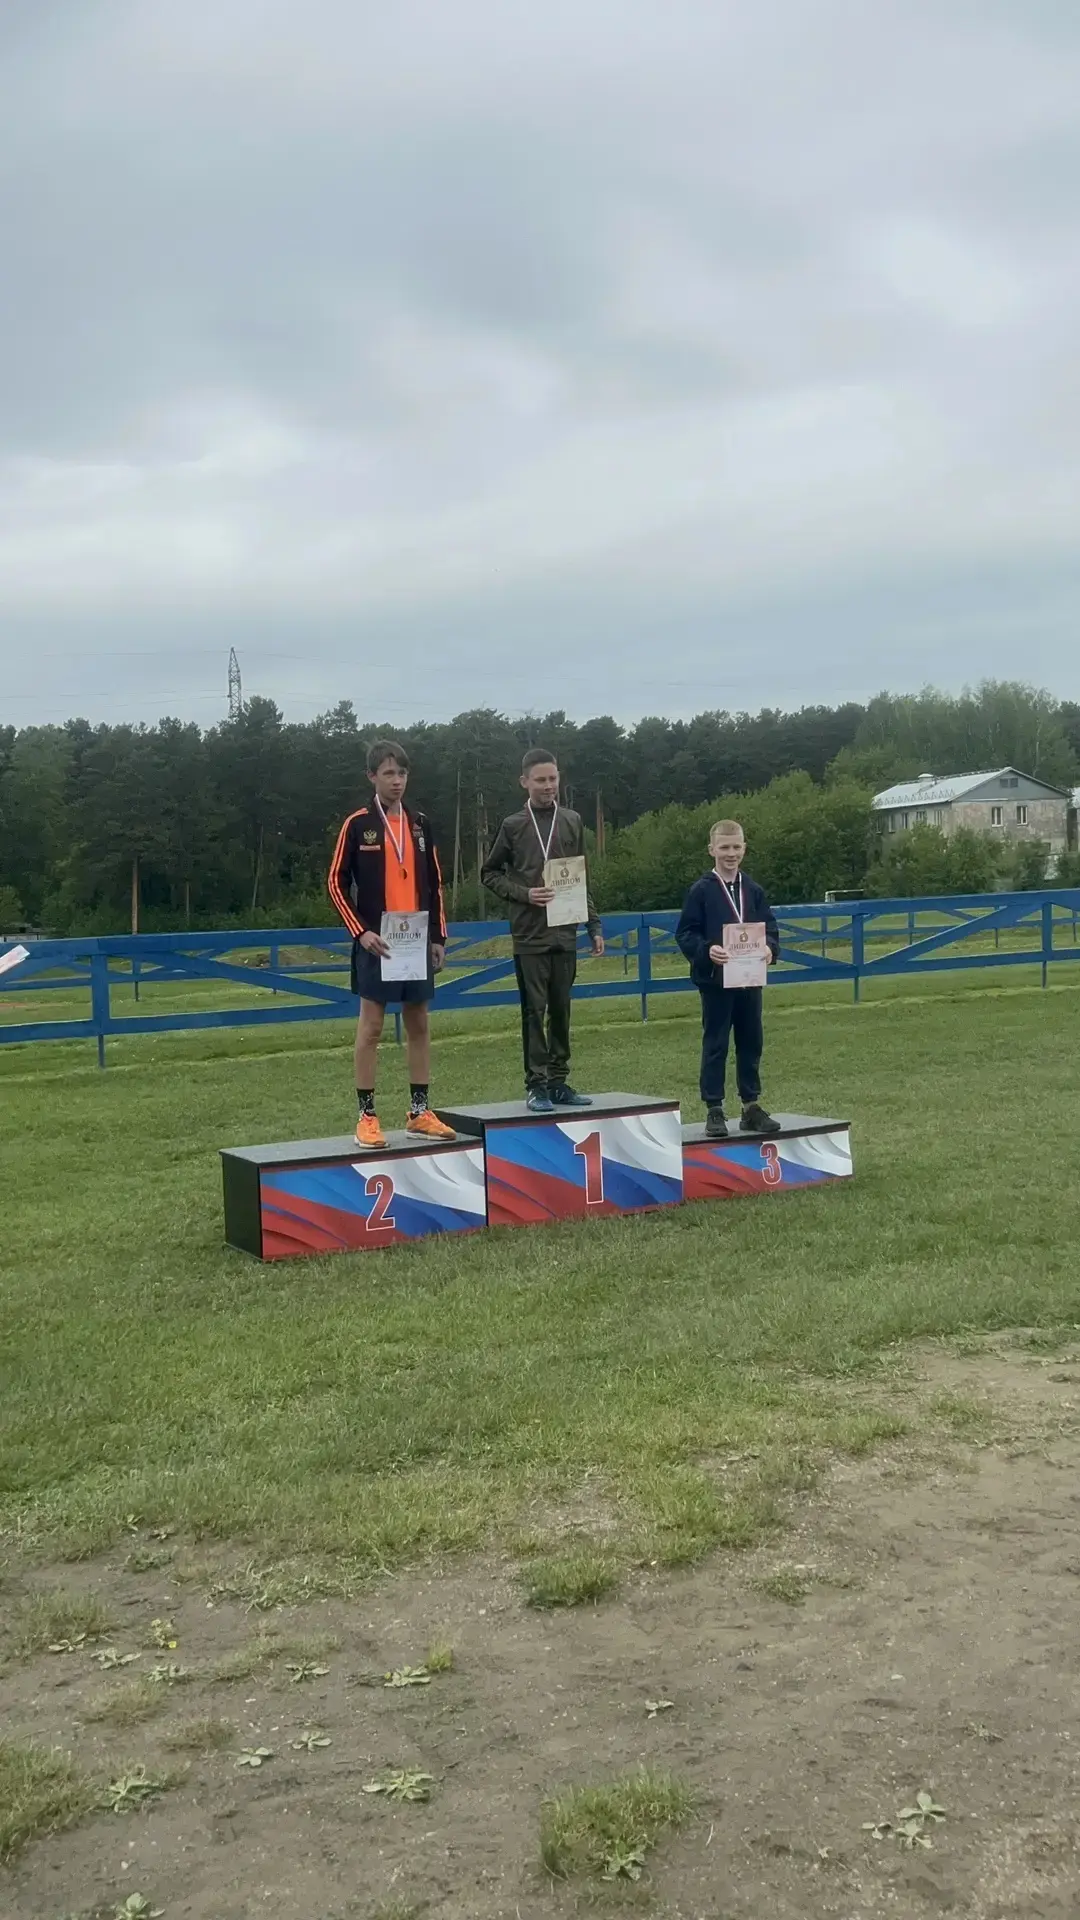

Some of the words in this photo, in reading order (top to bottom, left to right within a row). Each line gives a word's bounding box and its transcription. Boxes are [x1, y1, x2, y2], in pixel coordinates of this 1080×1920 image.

[551, 877, 580, 887] ДИПЛОМ
[387, 932, 421, 940] ДИПЛОМ
[573, 1130, 604, 1205] 1
[760, 1141, 782, 1185] 3
[365, 1174, 395, 1232] 2
